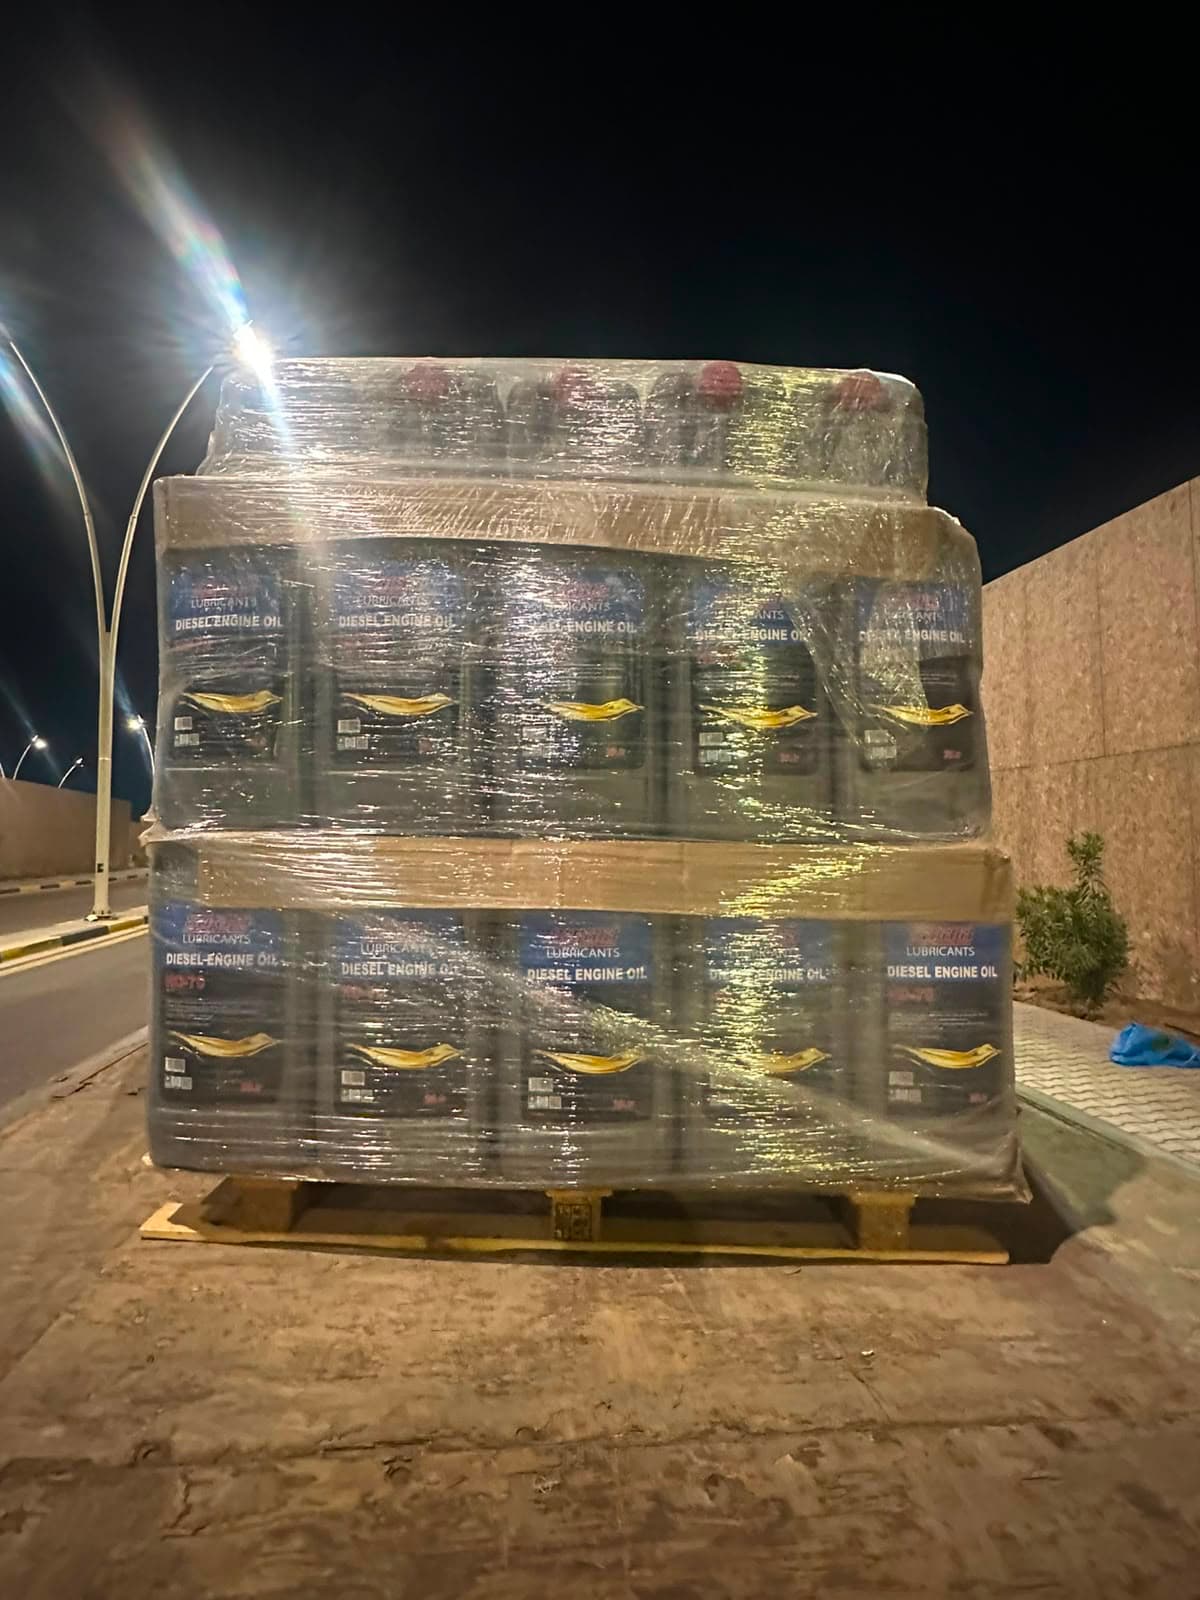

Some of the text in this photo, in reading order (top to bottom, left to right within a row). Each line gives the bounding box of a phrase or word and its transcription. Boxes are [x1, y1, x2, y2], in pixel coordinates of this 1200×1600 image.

[175, 614, 284, 631] DIESEL ENGINE OIL
[338, 615, 381, 627] DIESEL
[384, 614, 433, 627] ENGINE
[567, 620, 614, 633] ENGINE
[617, 621, 637, 633] OIL
[904, 629, 948, 642] ENGINE
[949, 630, 966, 644] OIL
[182, 933, 252, 945] LUBRICANTS
[546, 946, 621, 959] LUBRICANTS
[906, 946, 976, 957] LUBRICANTS
[166, 952, 279, 967] DIESEL ENGINE OIL
[341, 962, 385, 976] DIESEL
[388, 962, 437, 977] ENGINE
[527, 967, 648, 981] DIESEL ENGINE OIL
[887, 965, 998, 979] DIESEL ENGINE OIL
